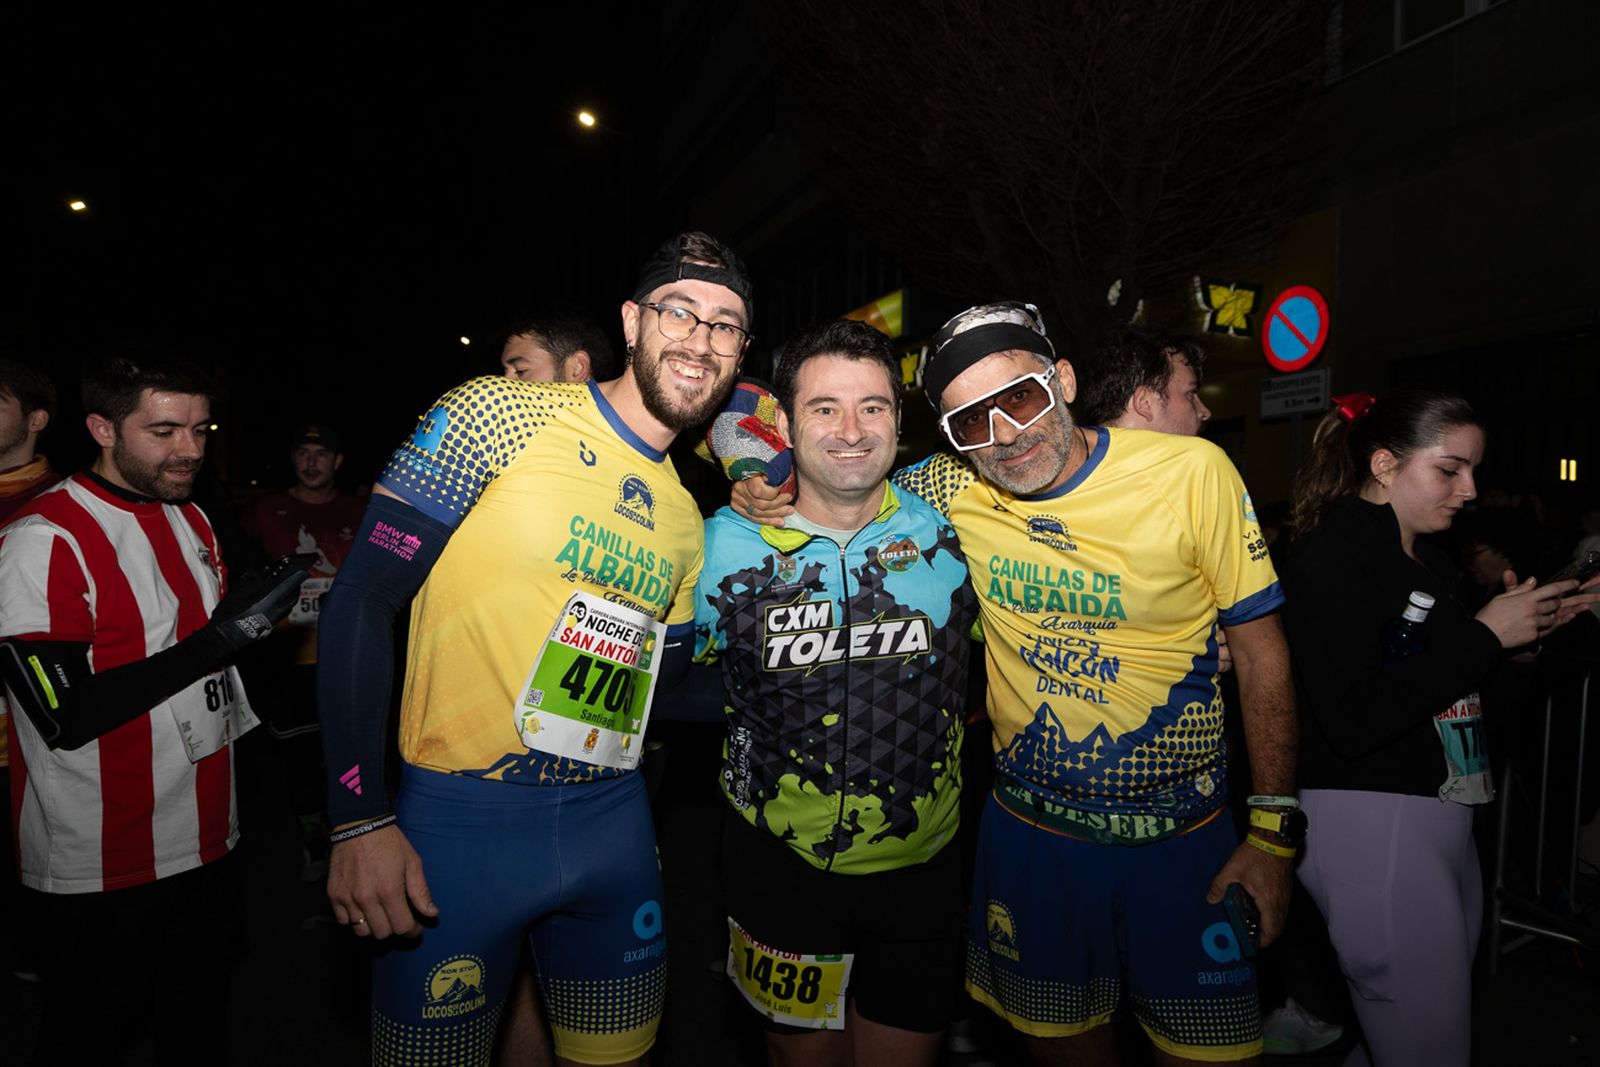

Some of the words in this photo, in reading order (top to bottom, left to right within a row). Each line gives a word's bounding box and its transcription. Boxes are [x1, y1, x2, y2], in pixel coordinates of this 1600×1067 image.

[372, 530, 400, 546] BERLIN
[375, 521, 405, 539] BMW
[368, 536, 413, 561] MARATHON
[570, 515, 655, 572] CANILLAS
[659, 556, 673, 583] DE
[880, 550, 918, 560] TOLETA
[554, 538, 671, 609] ALBAIDA
[989, 555, 1084, 592] CANILLAS
[1092, 572, 1121, 594] DE
[570, 605, 586, 619] 43
[987, 577, 1129, 621] ALBAIDA
[585, 615, 633, 642] NOCHE
[767, 602, 830, 633] CXM
[1040, 615, 1118, 636] Axarquía
[560, 627, 595, 651] SAN
[767, 620, 929, 668] TOLETA
[1036, 676, 1110, 704] DENTAL
[460, 965, 477, 973] STOP
[744, 946, 823, 1004] 1438
[422, 1004, 454, 1019] LOCOS
[459, 993, 487, 1015] COLINA
[774, 1001, 792, 1014] Luis
